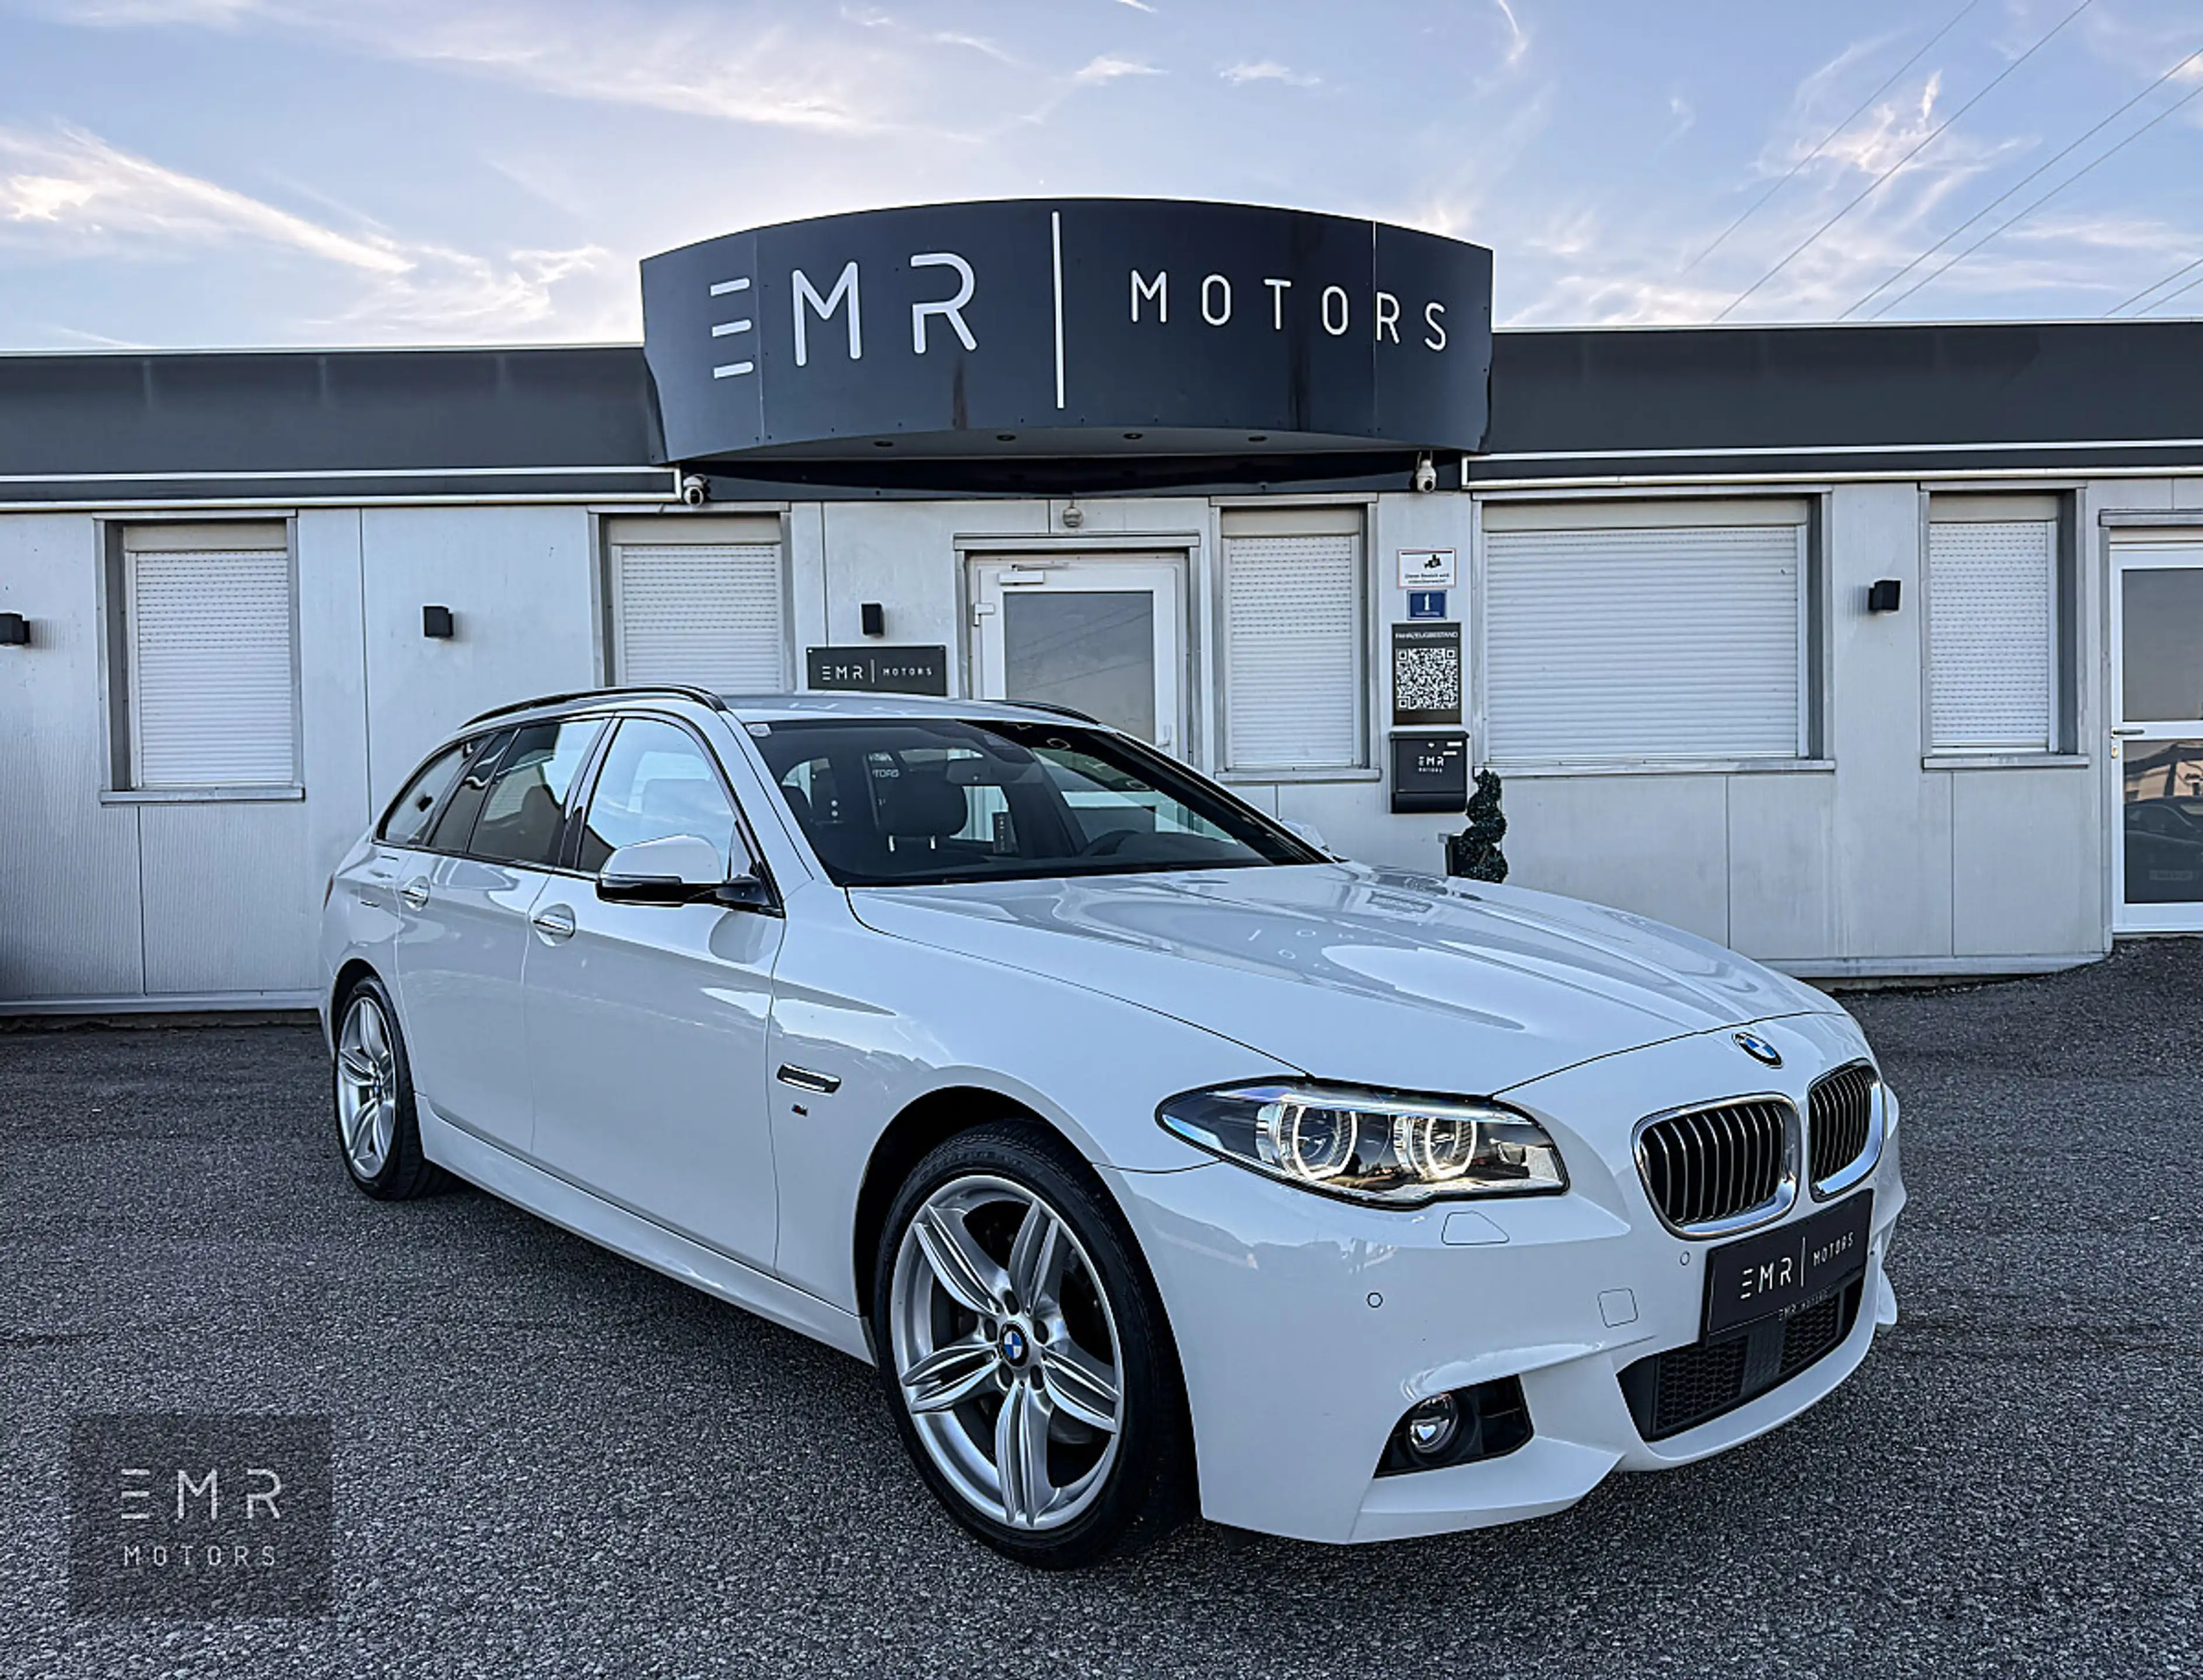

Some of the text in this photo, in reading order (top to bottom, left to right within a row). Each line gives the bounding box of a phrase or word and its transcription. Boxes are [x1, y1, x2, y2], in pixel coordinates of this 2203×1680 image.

[710, 253, 1447, 379] EMR MOTORS
[822, 665, 933, 681] EMR MOTORS
[1740, 1231, 1854, 1300] EMR MOTORS
